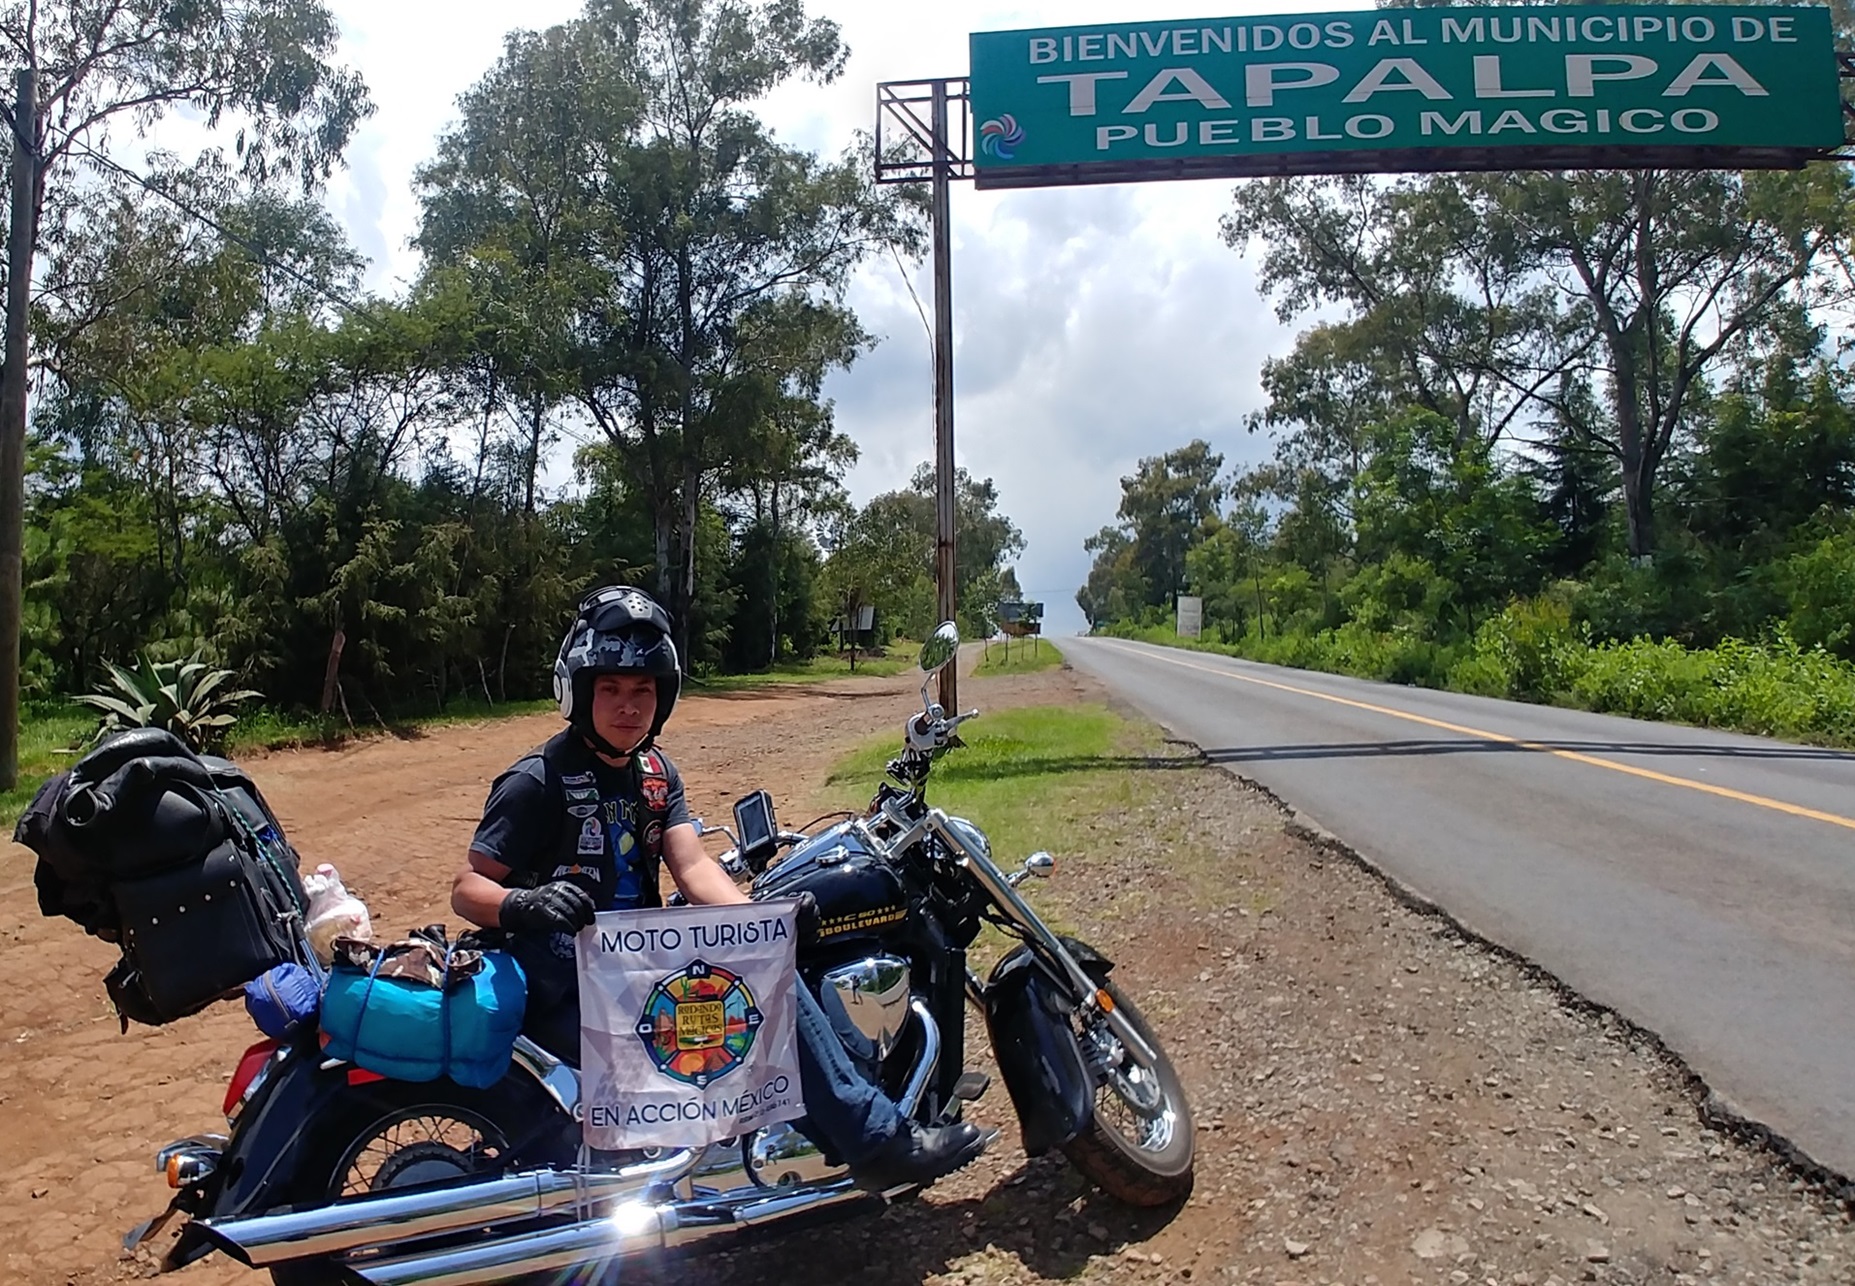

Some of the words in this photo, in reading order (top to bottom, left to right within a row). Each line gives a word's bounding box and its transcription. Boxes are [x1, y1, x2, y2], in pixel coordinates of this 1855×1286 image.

[1029, 24, 1354, 64] BIENVENIDOS
[1368, 19, 1427, 46] AL
[1441, 17, 1715, 43] MUNICIPIO
[1732, 17, 1797, 42] DE
[1037, 53, 1769, 116] TAPALPA
[1096, 114, 1394, 150] PUEBLO
[1420, 108, 1719, 135] MAGICO
[601, 928, 682, 953] MOTO
[688, 917, 788, 949] TURISTA
[825, 913, 895, 935] BOULEVARD
[692, 965, 705, 975] N
[748, 1013, 760, 1024] E
[591, 1105, 620, 1127] EN
[625, 1097, 717, 1126] ACCIÓN
[722, 1075, 790, 1117] MÉXICO
